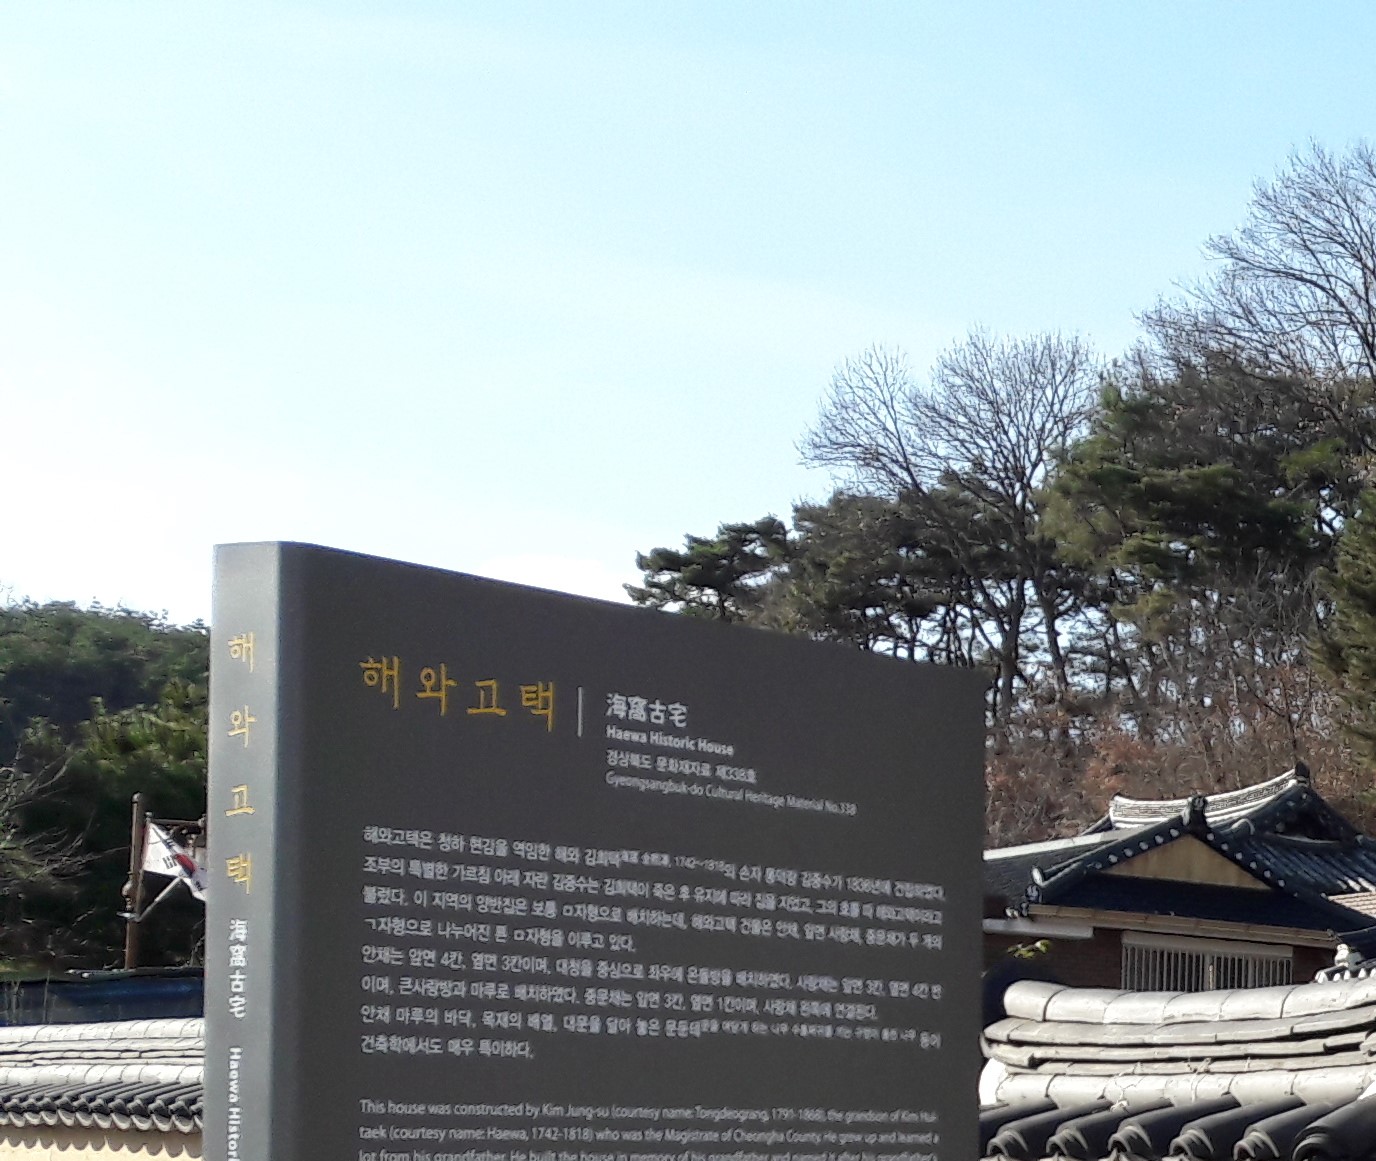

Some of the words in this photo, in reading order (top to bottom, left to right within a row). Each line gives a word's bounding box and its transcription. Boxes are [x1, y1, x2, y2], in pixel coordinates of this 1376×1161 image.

[359, 656, 553, 732] 해와고택
[605, 693, 688, 728] 海窩古宅
[607, 726, 647, 743] Haewa
[650, 732, 695, 750] Historic
[698, 739, 734, 755] House
[226, 631, 256, 895] 해와고택
[607, 750, 652, 768] 경상북도
[657, 757, 712, 776] 문화재자료
[606, 772, 704, 795] Gyeongsangbuk-do
[706, 785, 743, 800] Cultural
[229, 1047, 242, 1103] Haewa
[360, 1100, 386, 1114] This
[388, 1101, 426, 1115] house
[428, 1105, 452, 1115] was
[453, 1104, 524, 1116] constructed
[526, 1104, 540, 1120] by
[542, 1104, 564, 1116] Kim
[359, 1126, 386, 1139] taek
